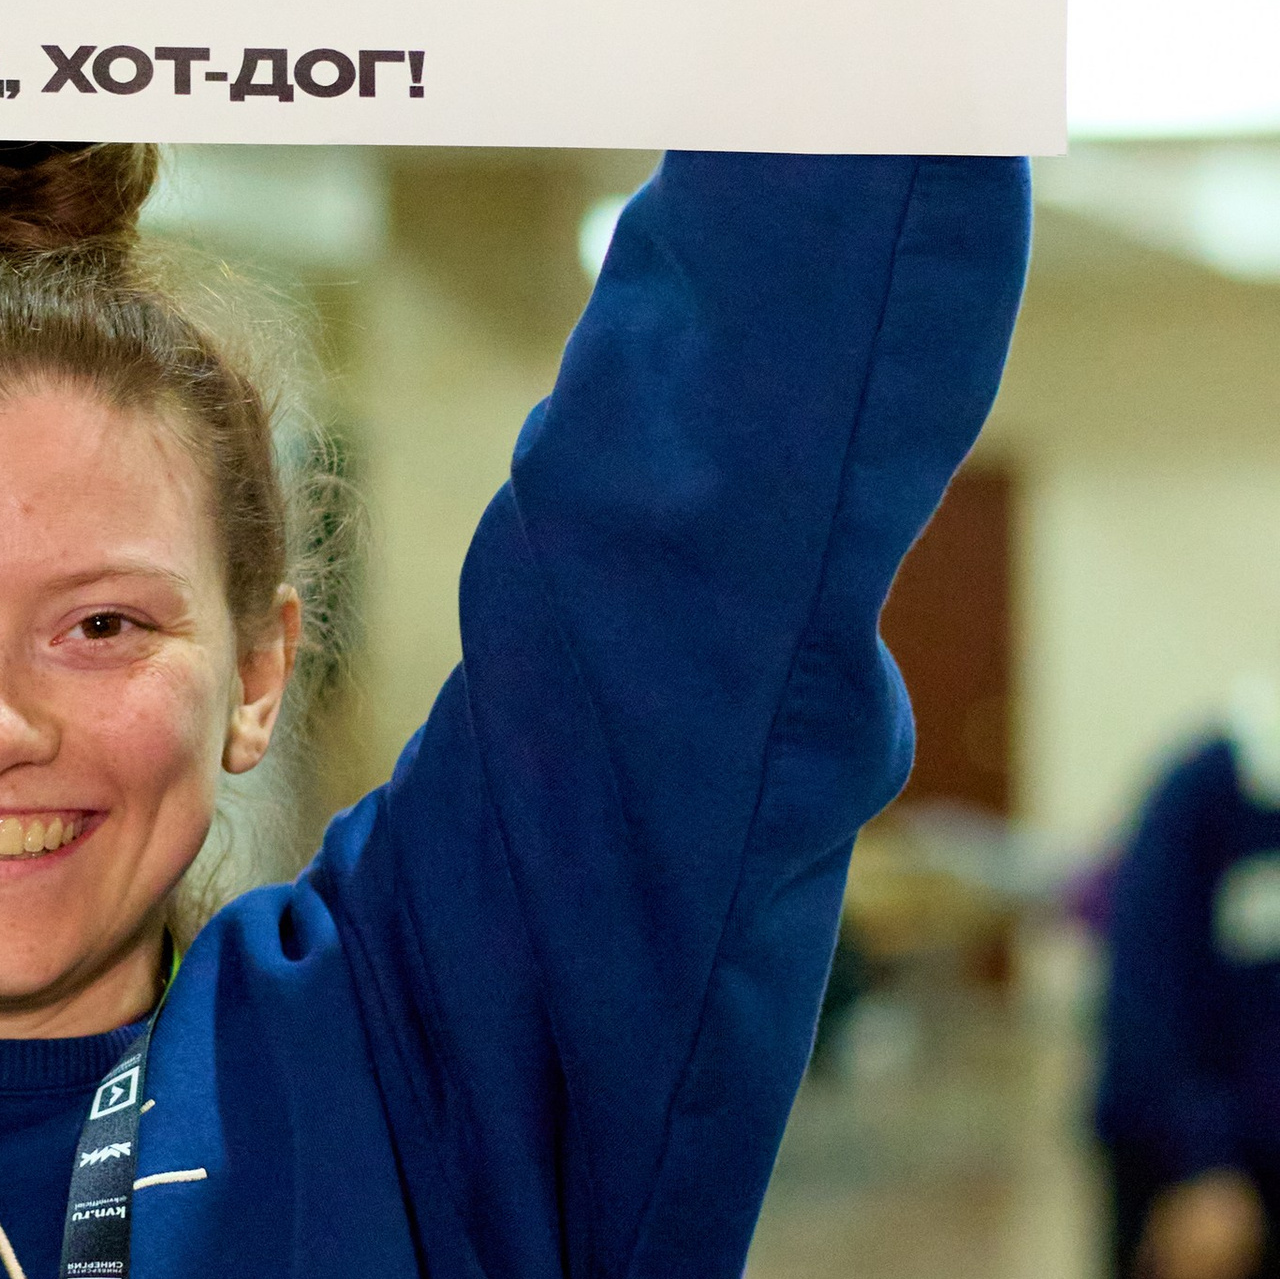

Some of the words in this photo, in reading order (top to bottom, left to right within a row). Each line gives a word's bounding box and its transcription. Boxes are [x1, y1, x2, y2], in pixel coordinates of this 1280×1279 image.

[41, 44, 426, 103] ХОТ-ДОГ!
[72, 1205, 126, 1222] kvn.ru
[67, 1261, 124, 1270] СИНЕРГИЯ
